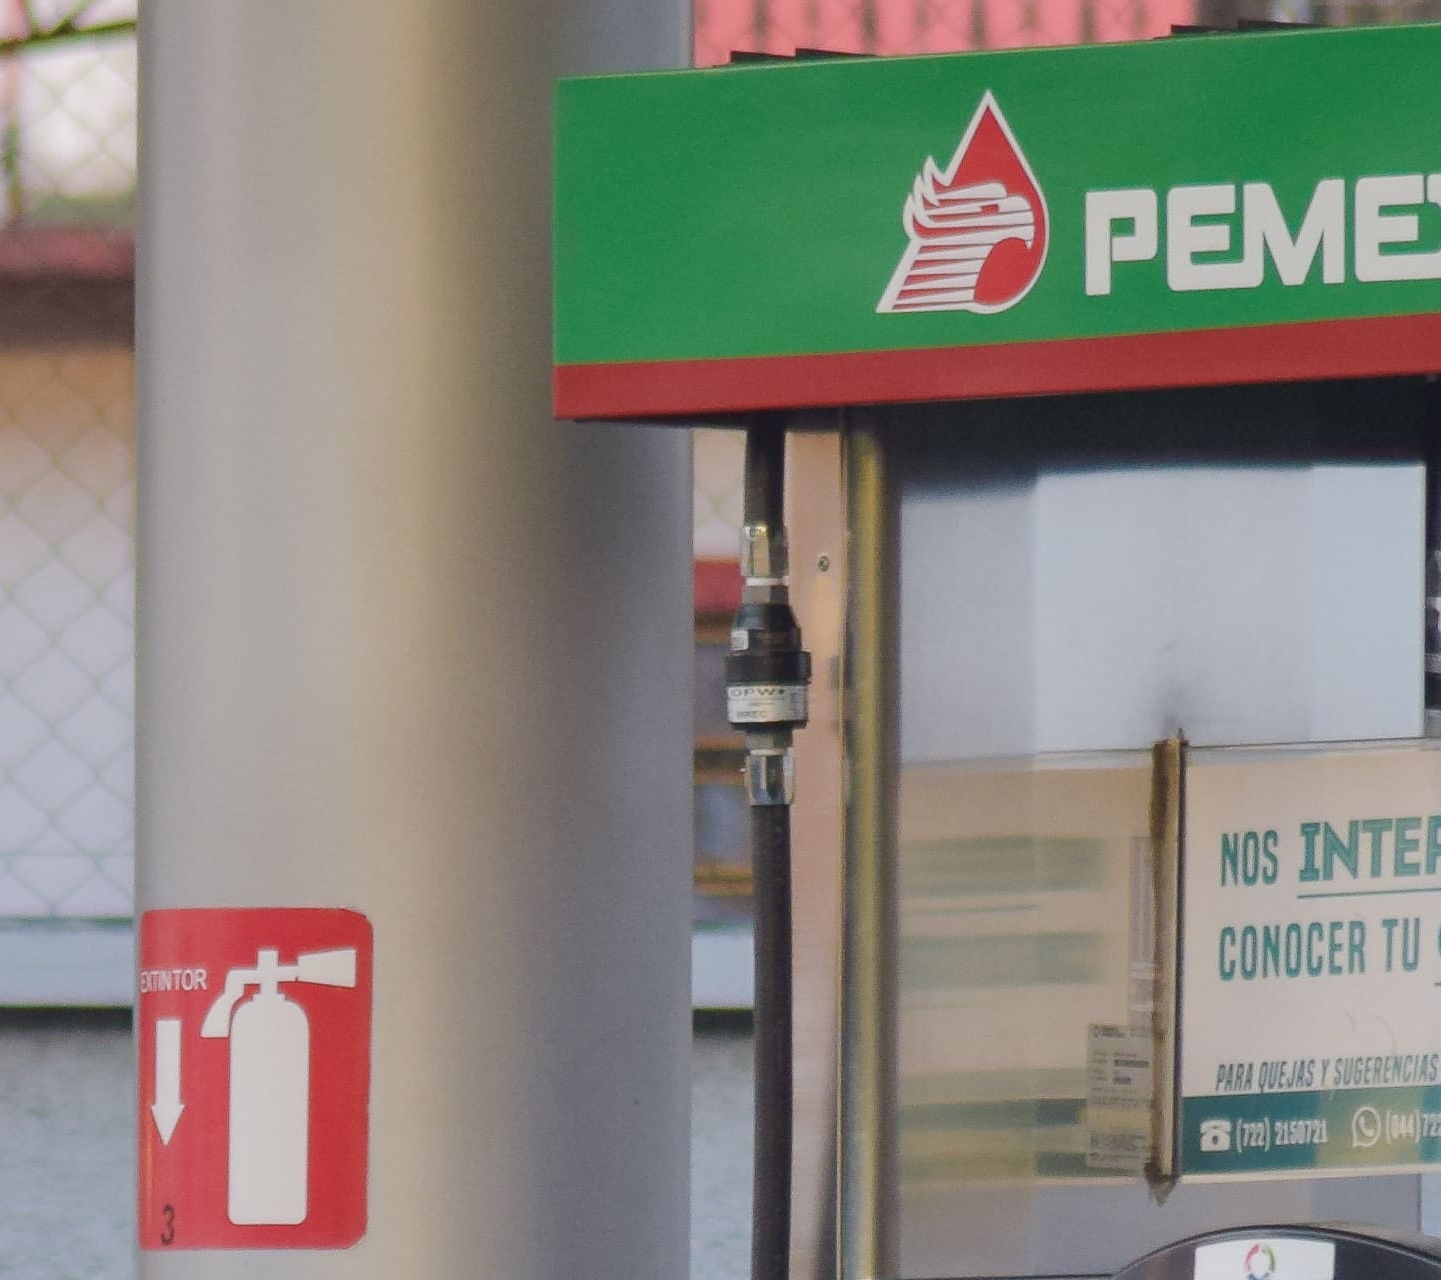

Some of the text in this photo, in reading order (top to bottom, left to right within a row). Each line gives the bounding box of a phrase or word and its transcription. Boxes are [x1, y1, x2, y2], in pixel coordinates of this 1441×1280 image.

[1219, 829, 1279, 887] NOS
[1219, 919, 1367, 981] CONOCER
[1382, 916, 1420, 972] TU
[1215, 1062, 1253, 1092] PARA
[1258, 1058, 1316, 1093] QUEJAS
[1320, 1057, 1331, 1086] Y
[1334, 1054, 1438, 1086] SUGERENCIAS
